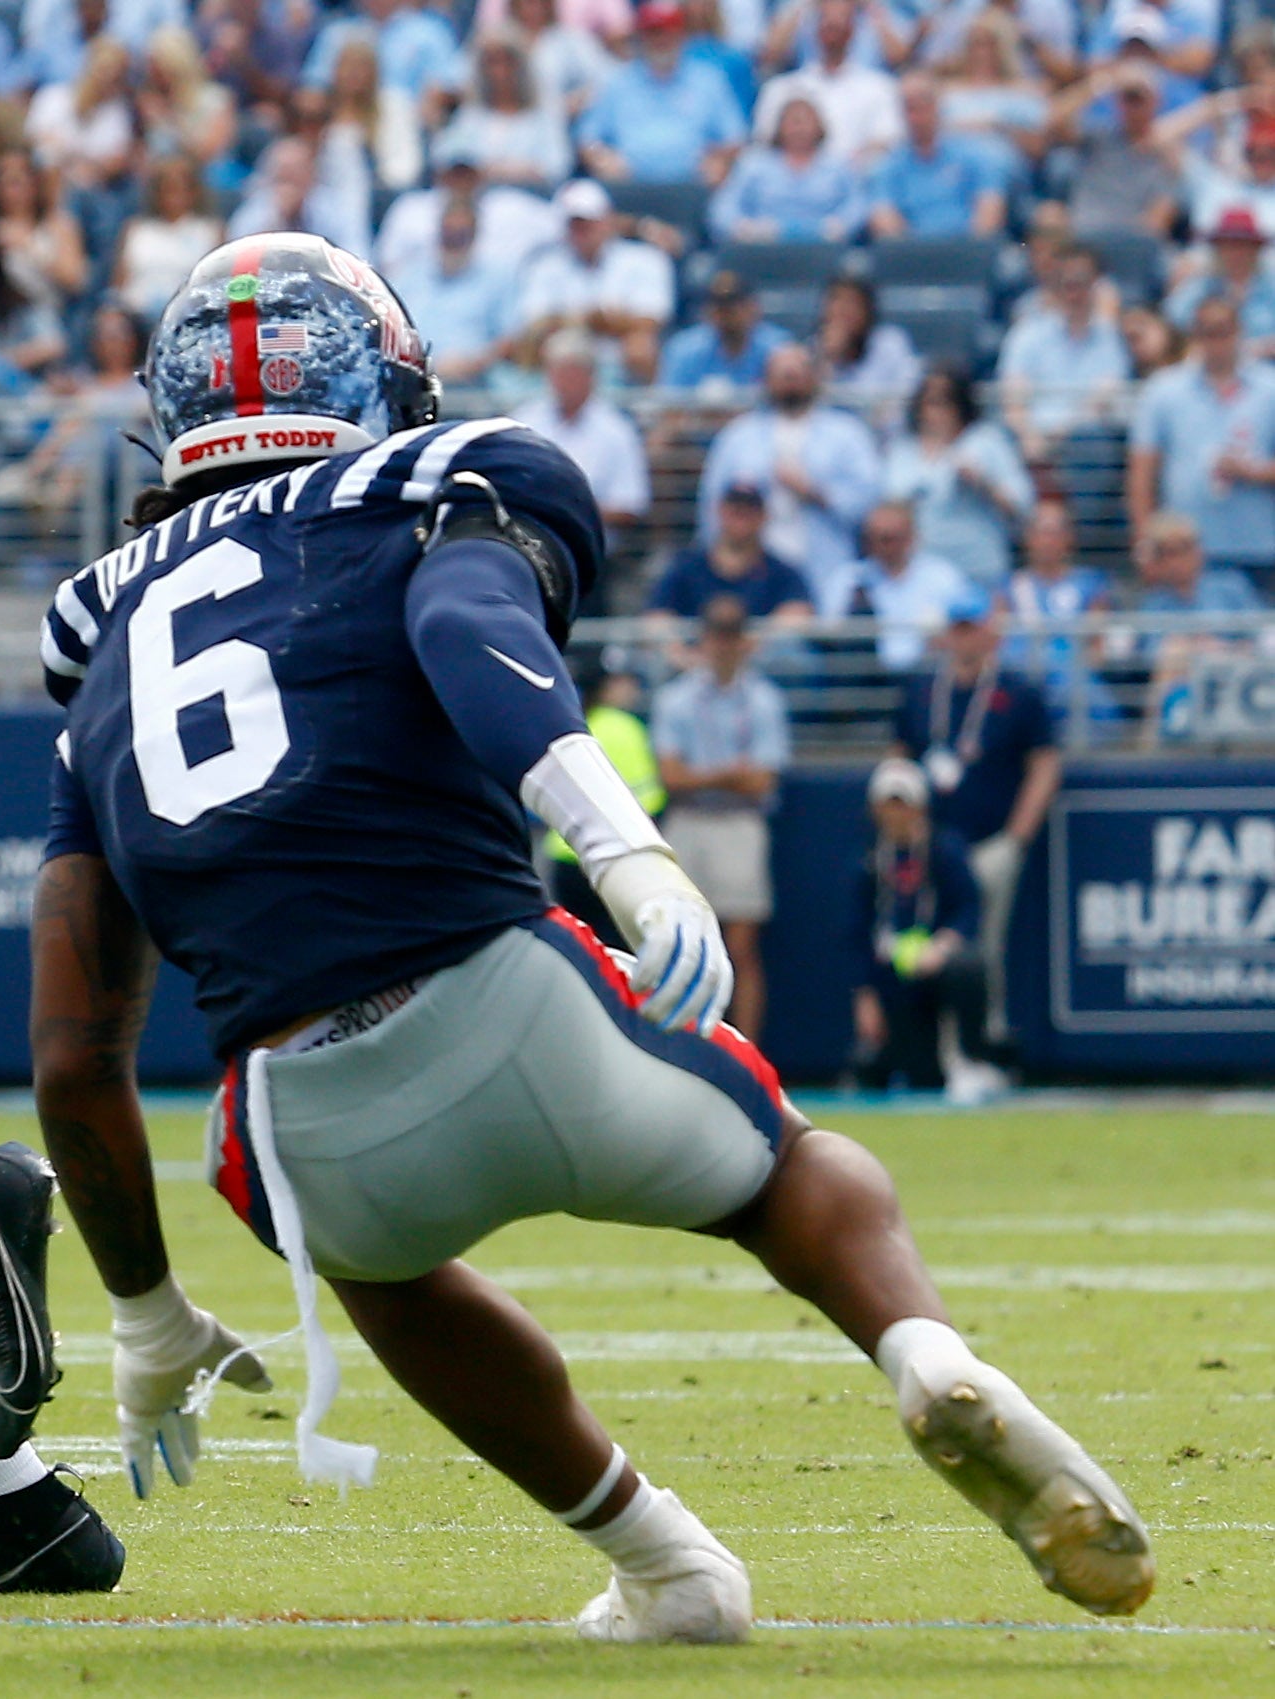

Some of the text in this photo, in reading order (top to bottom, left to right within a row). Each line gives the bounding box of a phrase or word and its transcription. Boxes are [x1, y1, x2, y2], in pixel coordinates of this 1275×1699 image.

[265, 358, 302, 392] SEC
[255, 430, 338, 449] TODDY
[93, 458, 331, 614] DOTTERY
[127, 536, 291, 827] 6
